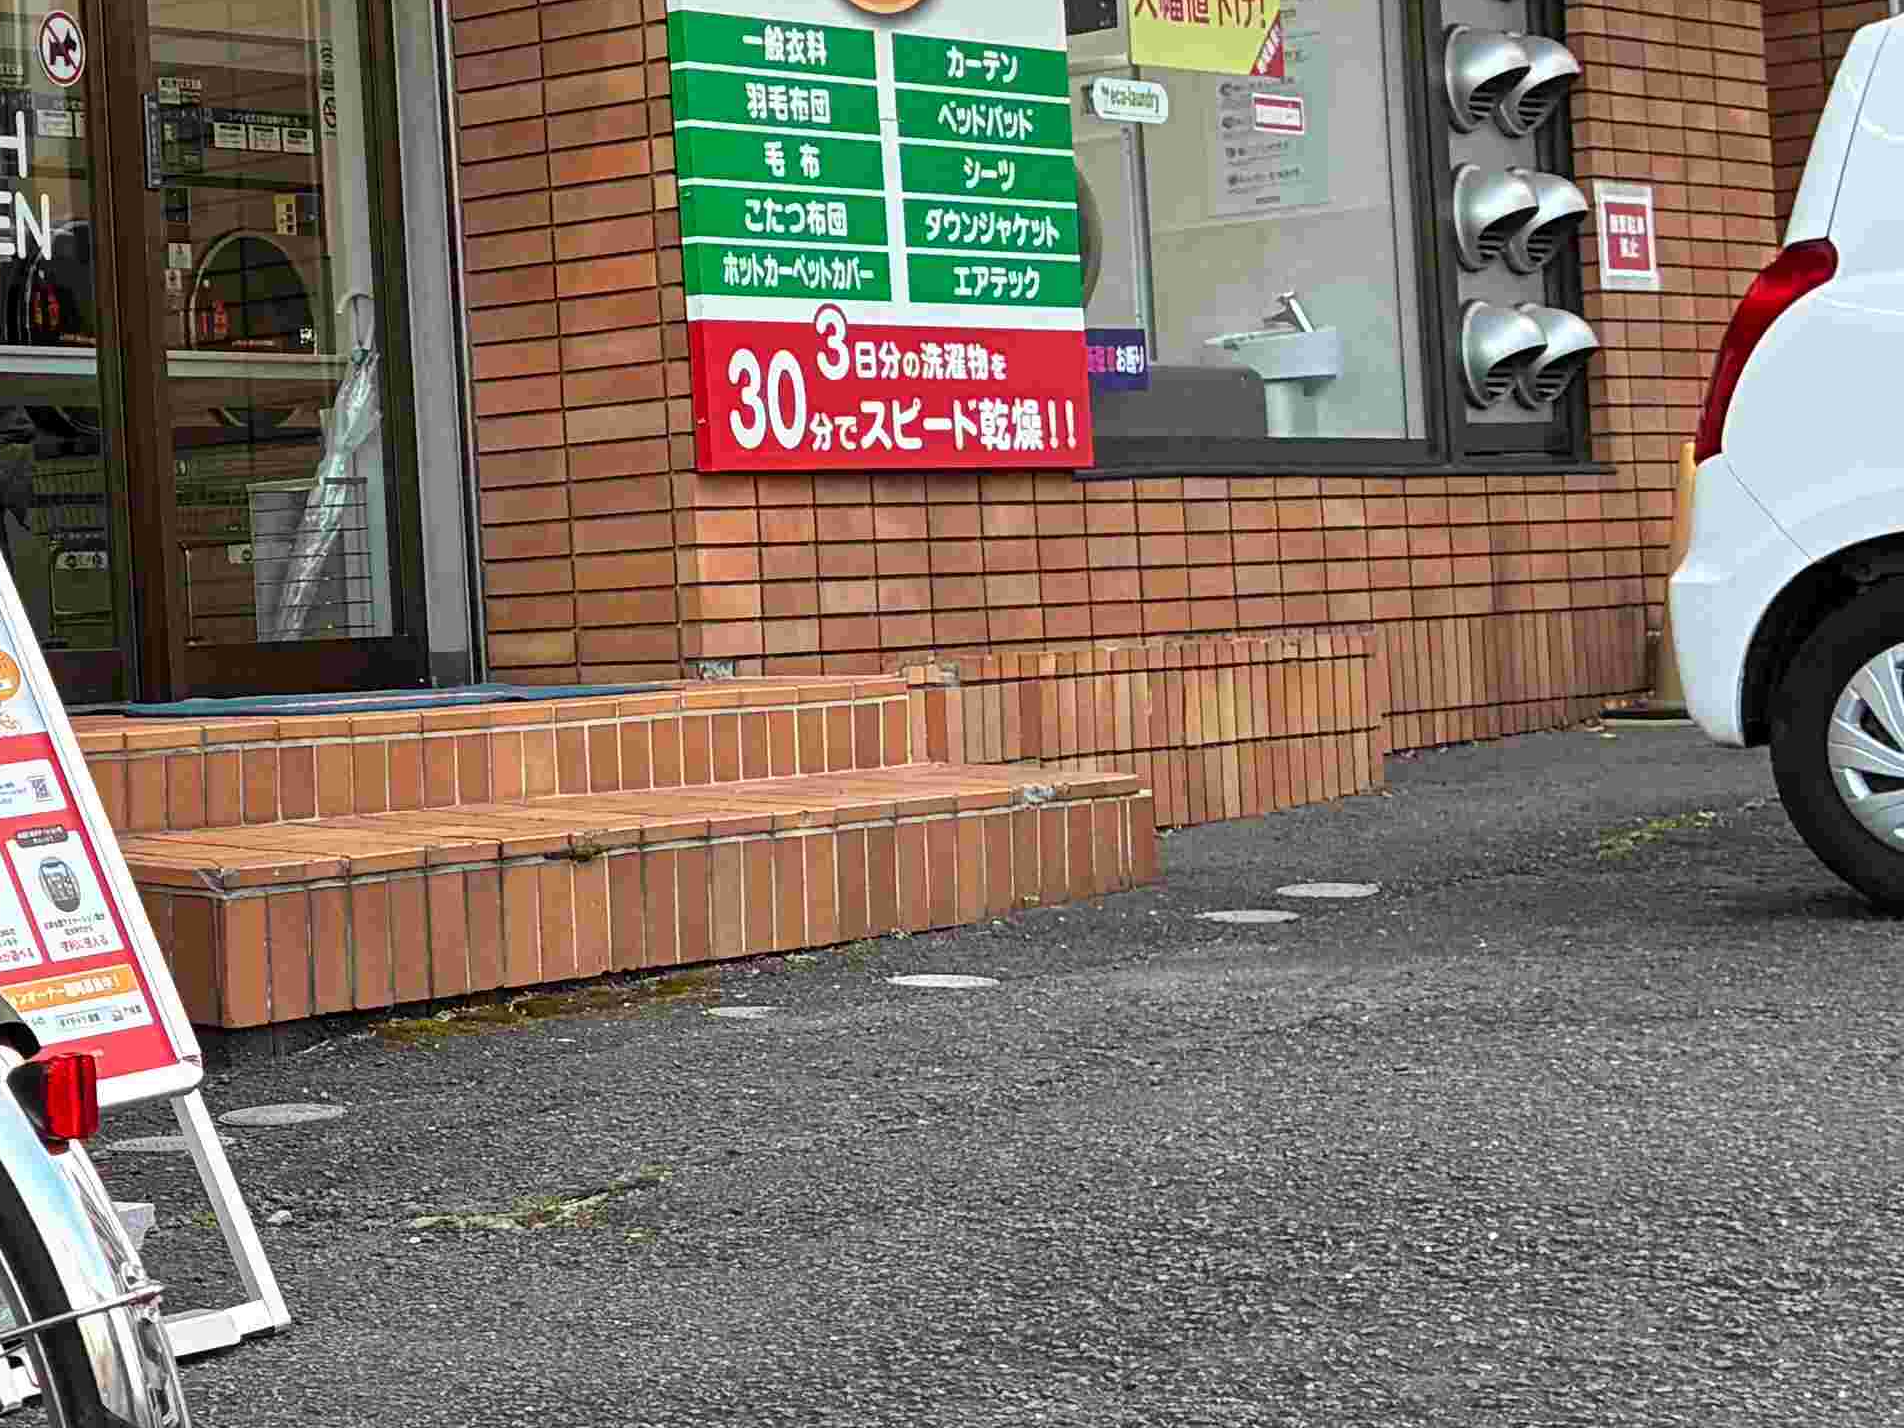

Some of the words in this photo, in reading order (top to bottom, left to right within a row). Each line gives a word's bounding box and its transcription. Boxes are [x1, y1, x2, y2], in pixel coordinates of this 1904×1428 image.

[742, 24, 827, 66] 一般衣料
[945, 46, 1018, 84] カーテン
[744, 82, 831, 124] 羽毛布団
[962, 156, 1016, 192] シーツ
[744, 197, 848, 238] こたつ布団
[924, 207, 1060, 248] ダウンジャケット
[723, 251, 874, 292] ホットカーペットカバー
[815, 307, 1008, 382] 3日分の洗濯物を
